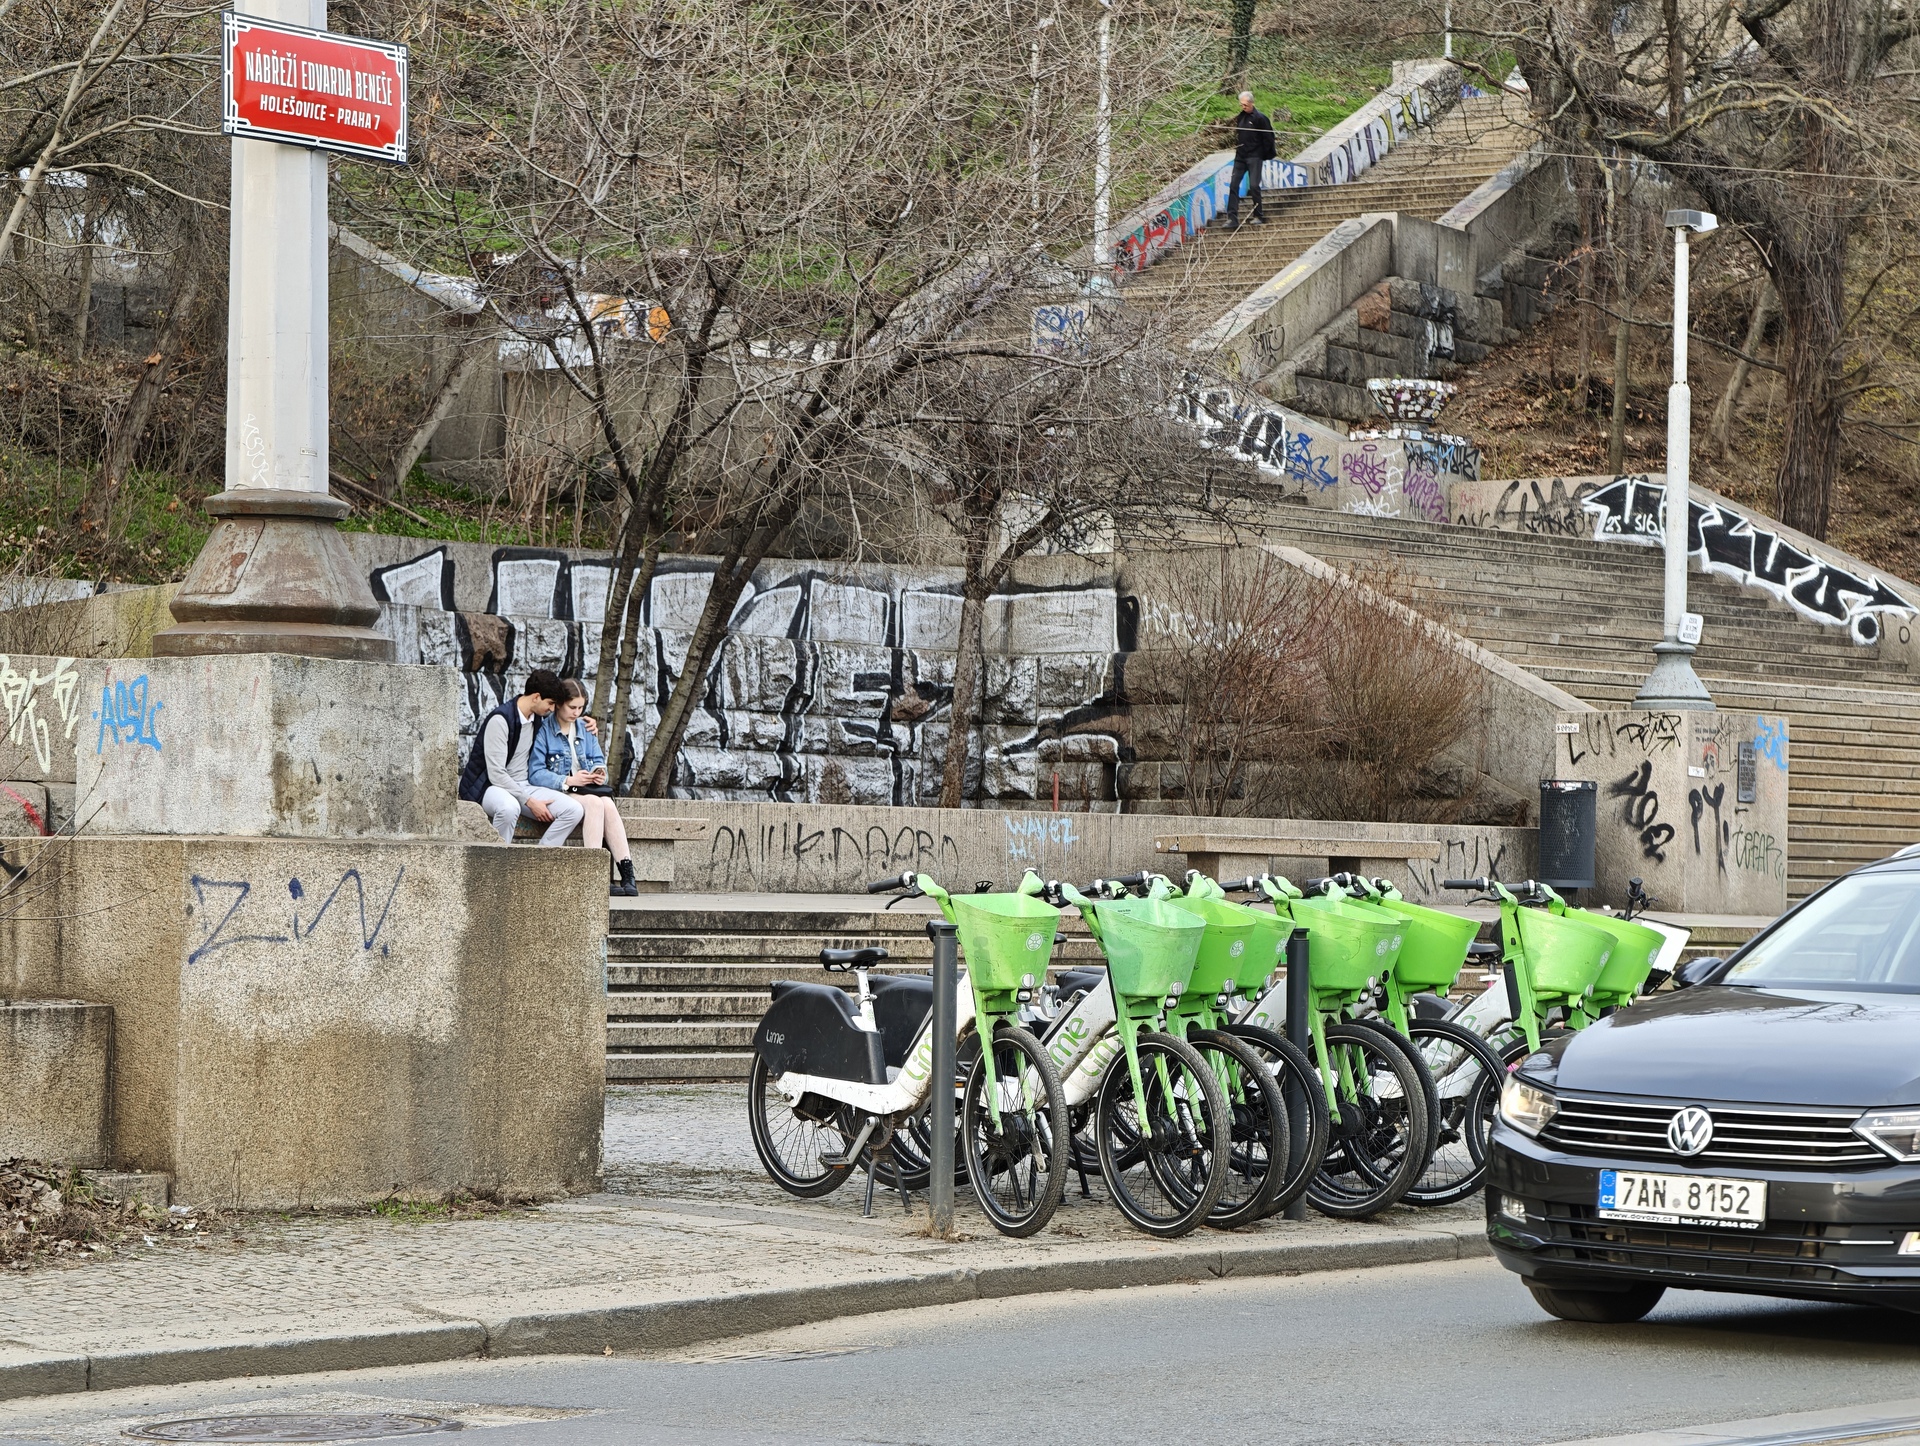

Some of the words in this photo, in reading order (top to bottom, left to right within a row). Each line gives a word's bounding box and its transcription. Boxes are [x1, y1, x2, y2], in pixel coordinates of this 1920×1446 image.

[245, 47, 298, 89] NÁBŘEŽÍ
[301, 60, 351, 99] EDVARDA
[355, 71, 393, 107] BENEŠE
[260, 94, 327, 122] HOLEŠOVICE
[337, 107, 372, 130] PRAHA
[374, 114, 381, 131] 7
[765, 1029, 786, 1045] Lime
[1601, 1195, 1615, 1205] CZ
[1622, 1177, 1667, 1208] 7AN
[1687, 1182, 1750, 1215] 8152
[1605, 1211, 1673, 1223] www.dovozy.cz
